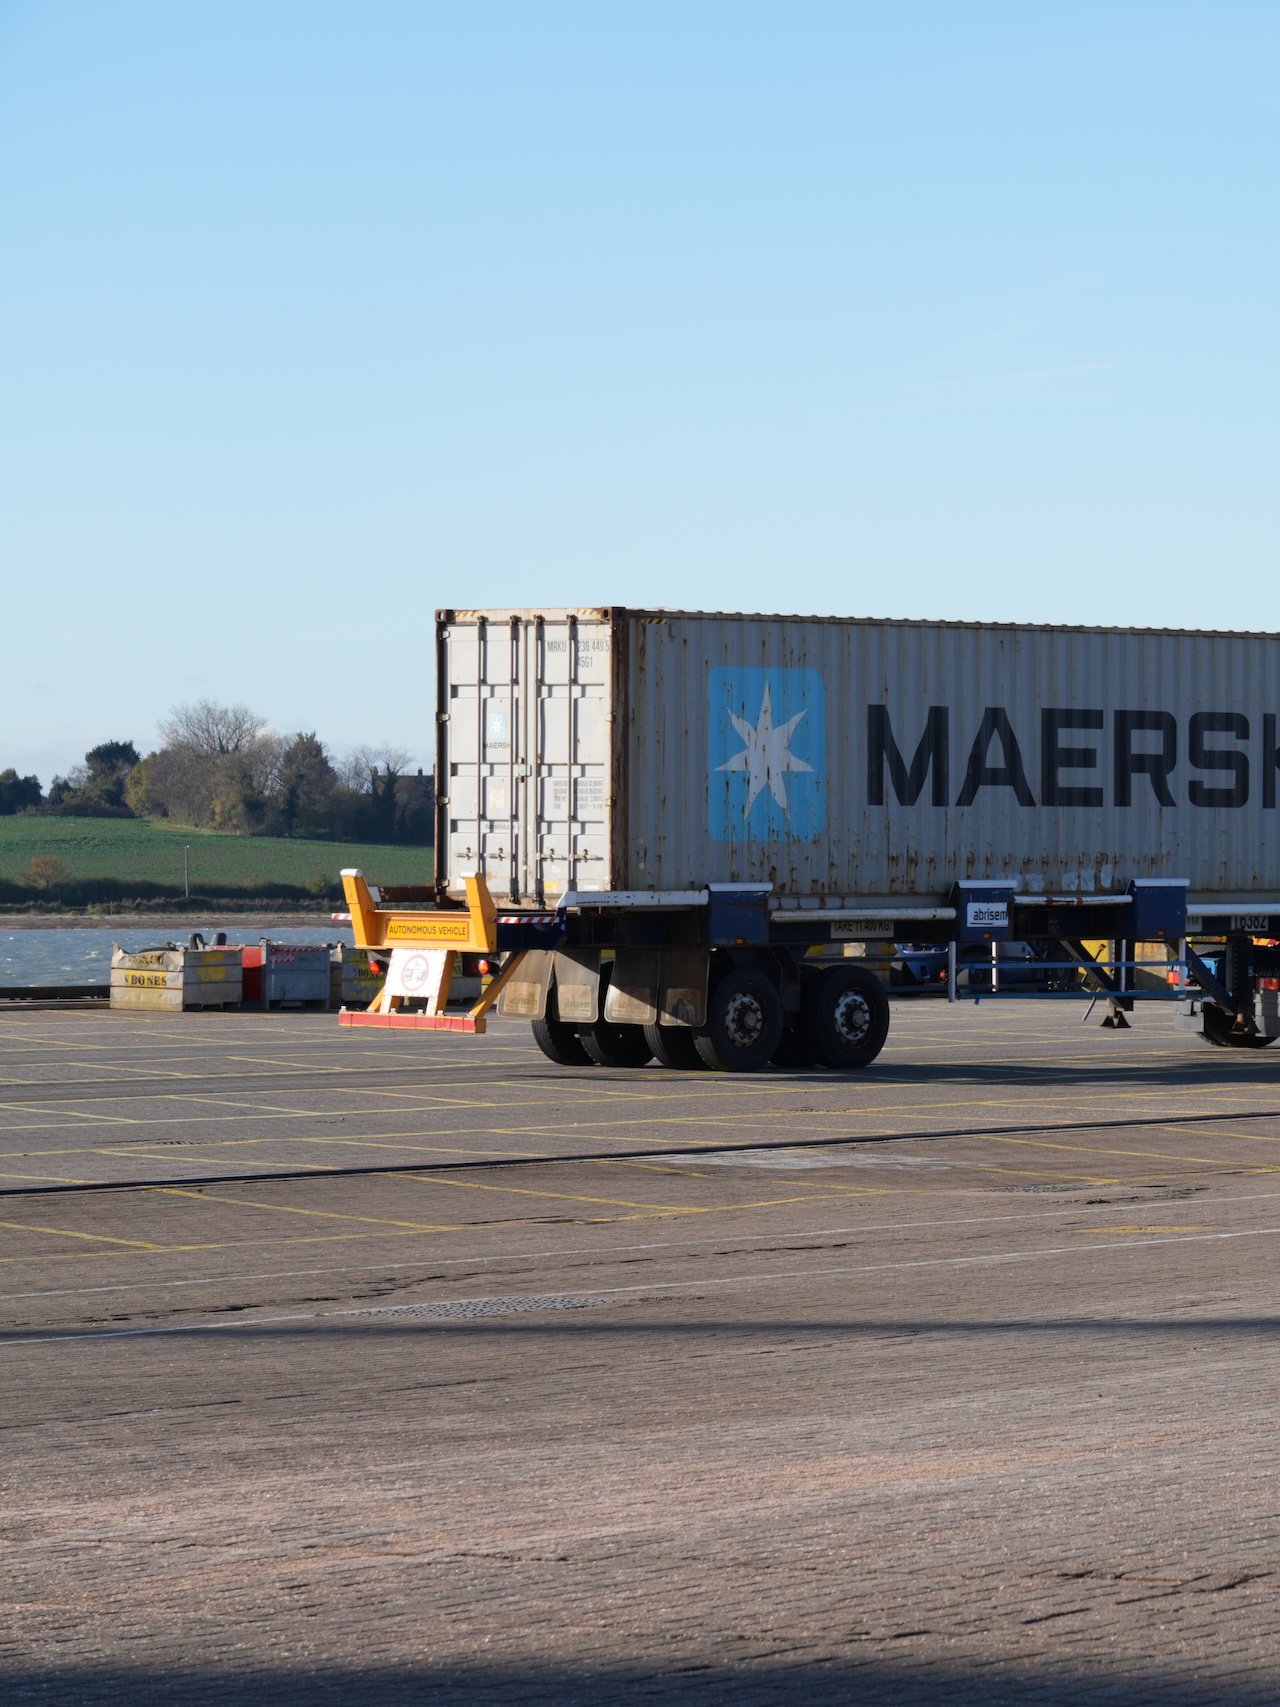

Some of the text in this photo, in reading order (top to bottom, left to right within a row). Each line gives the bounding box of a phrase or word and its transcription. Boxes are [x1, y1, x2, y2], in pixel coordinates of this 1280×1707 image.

[547, 641, 567, 653] MRKU
[973, 908, 1008, 921] abrisem
[389, 925, 467, 936] AUTONOMOUS VEHICLE
[834, 920, 853, 932] TARE
